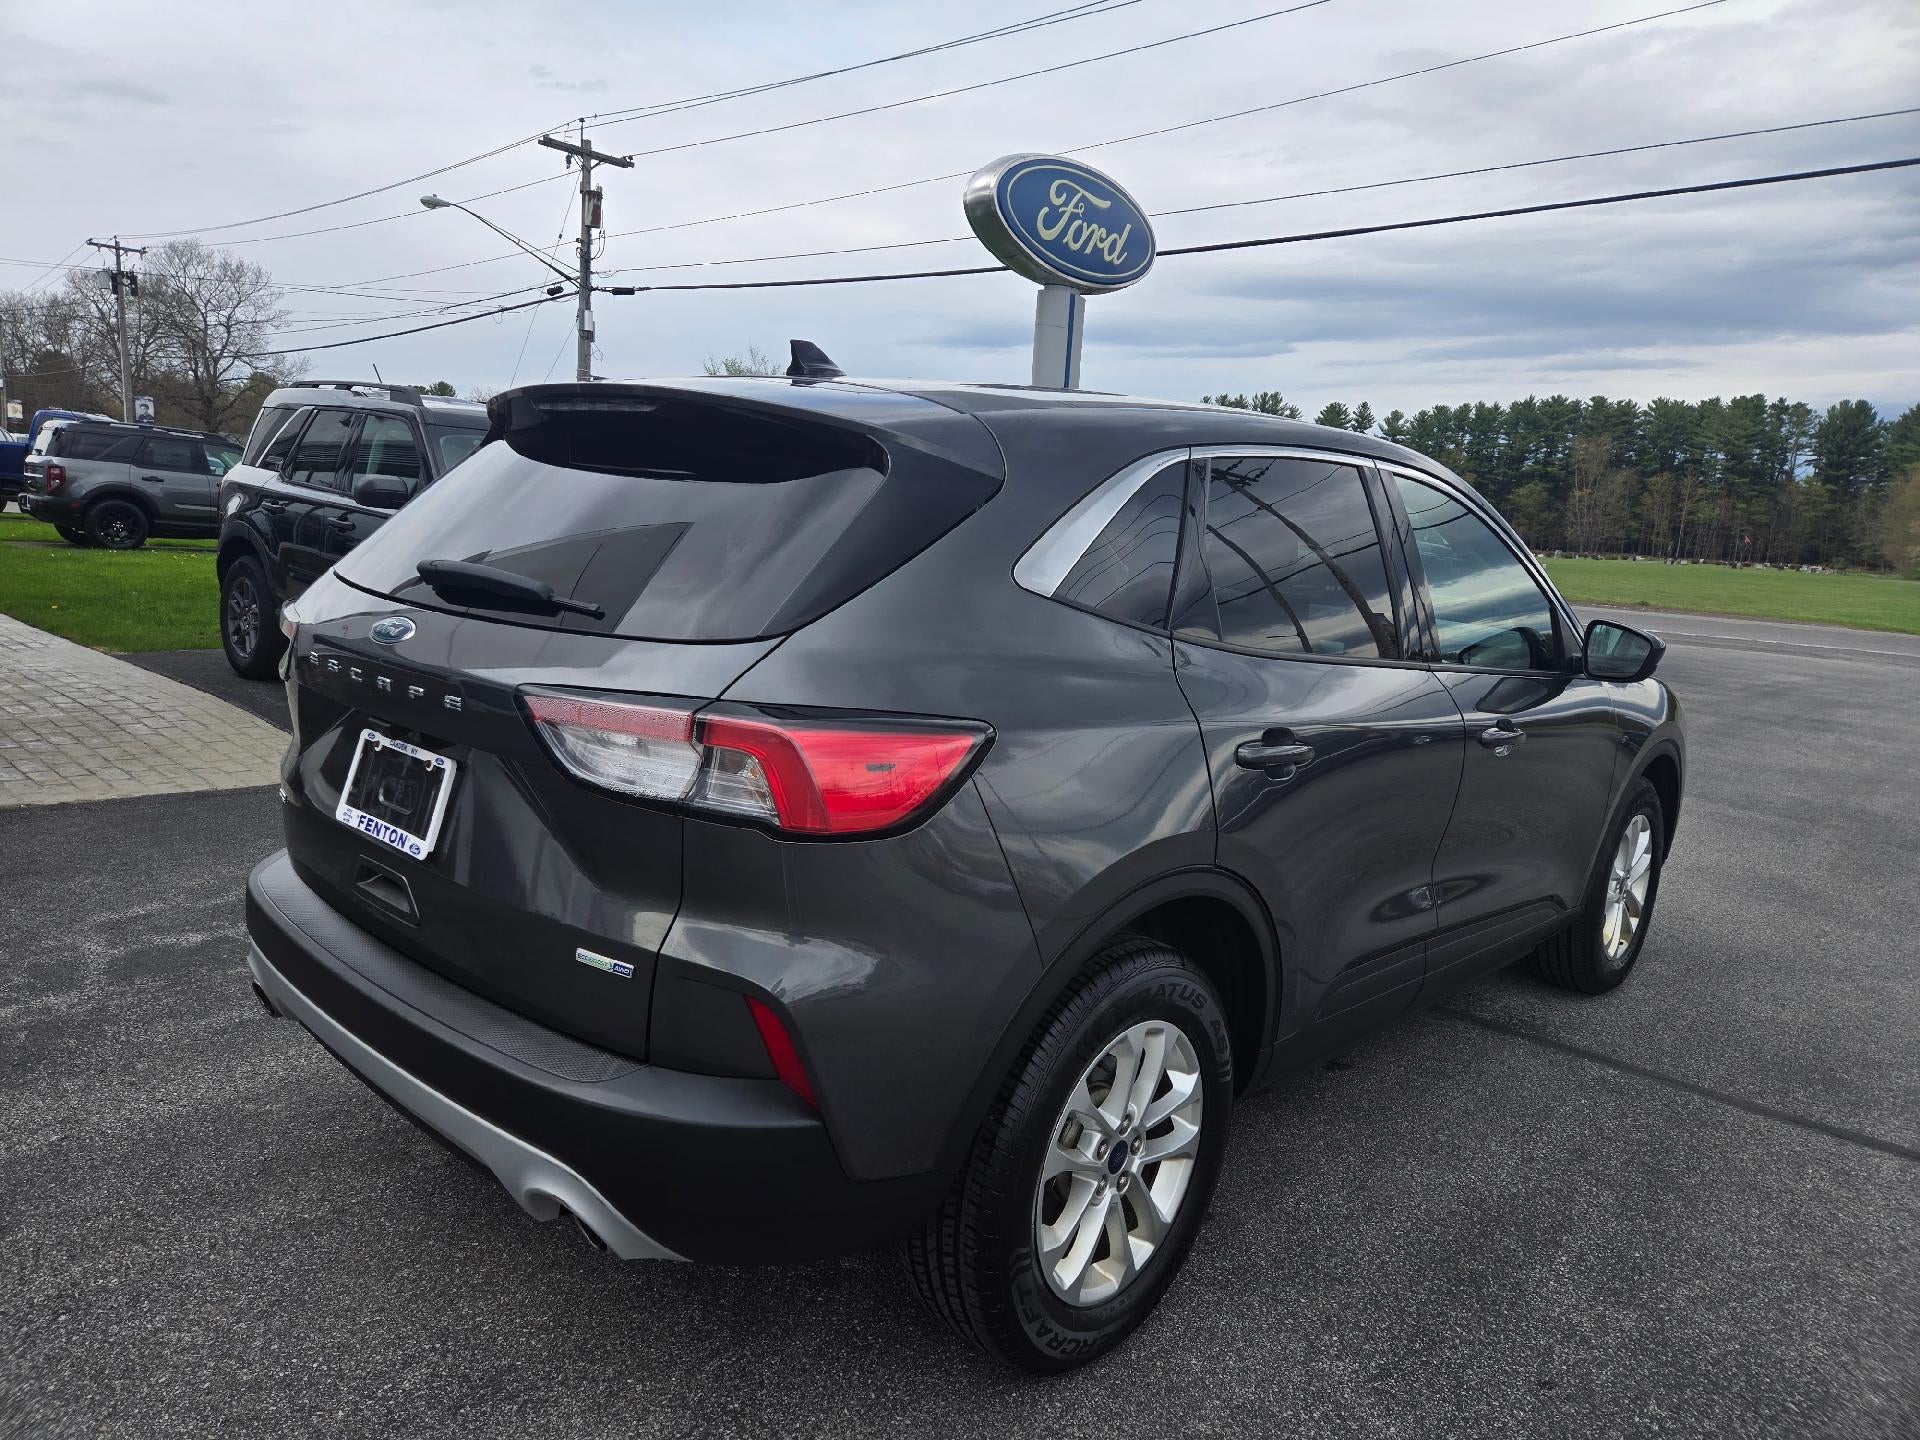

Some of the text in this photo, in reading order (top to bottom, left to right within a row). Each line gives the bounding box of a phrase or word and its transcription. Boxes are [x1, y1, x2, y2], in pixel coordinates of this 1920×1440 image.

[1036, 179, 1132, 265] Ford
[309, 651, 462, 711] ESCAPE
[358, 815, 408, 849] FENTON
[614, 964, 630, 974] AWD
